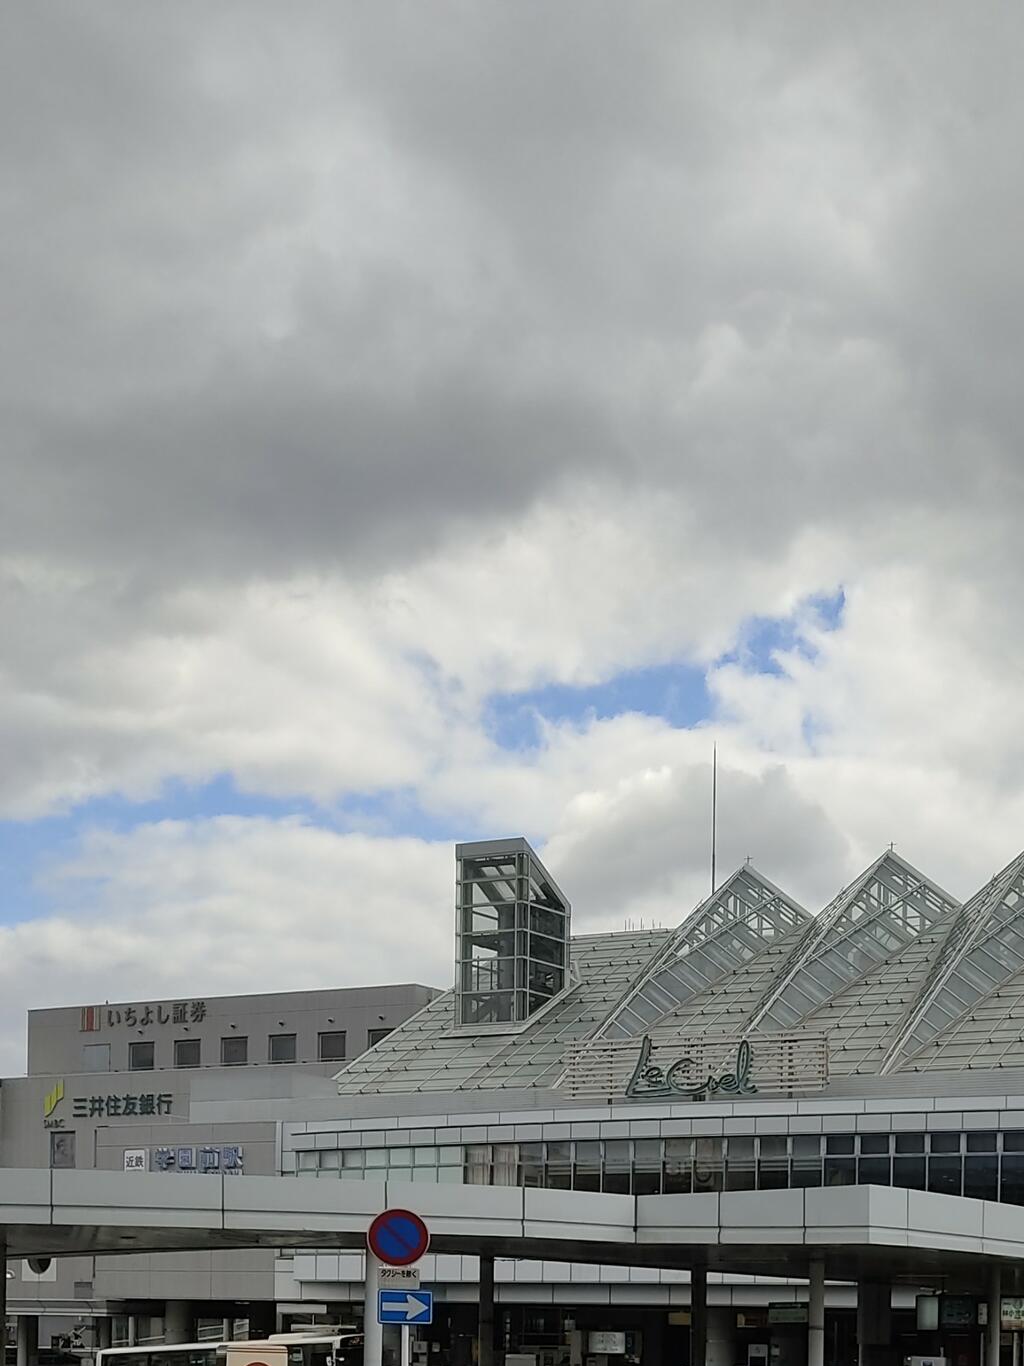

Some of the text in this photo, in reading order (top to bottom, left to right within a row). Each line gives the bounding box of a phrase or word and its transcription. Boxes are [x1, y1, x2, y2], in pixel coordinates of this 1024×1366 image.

[107, 1001, 207, 1027] いちよし証券
[72, 1093, 173, 1118] 三井住友銀行
[126, 1147, 242, 1170] 近鉄 学園前駅
